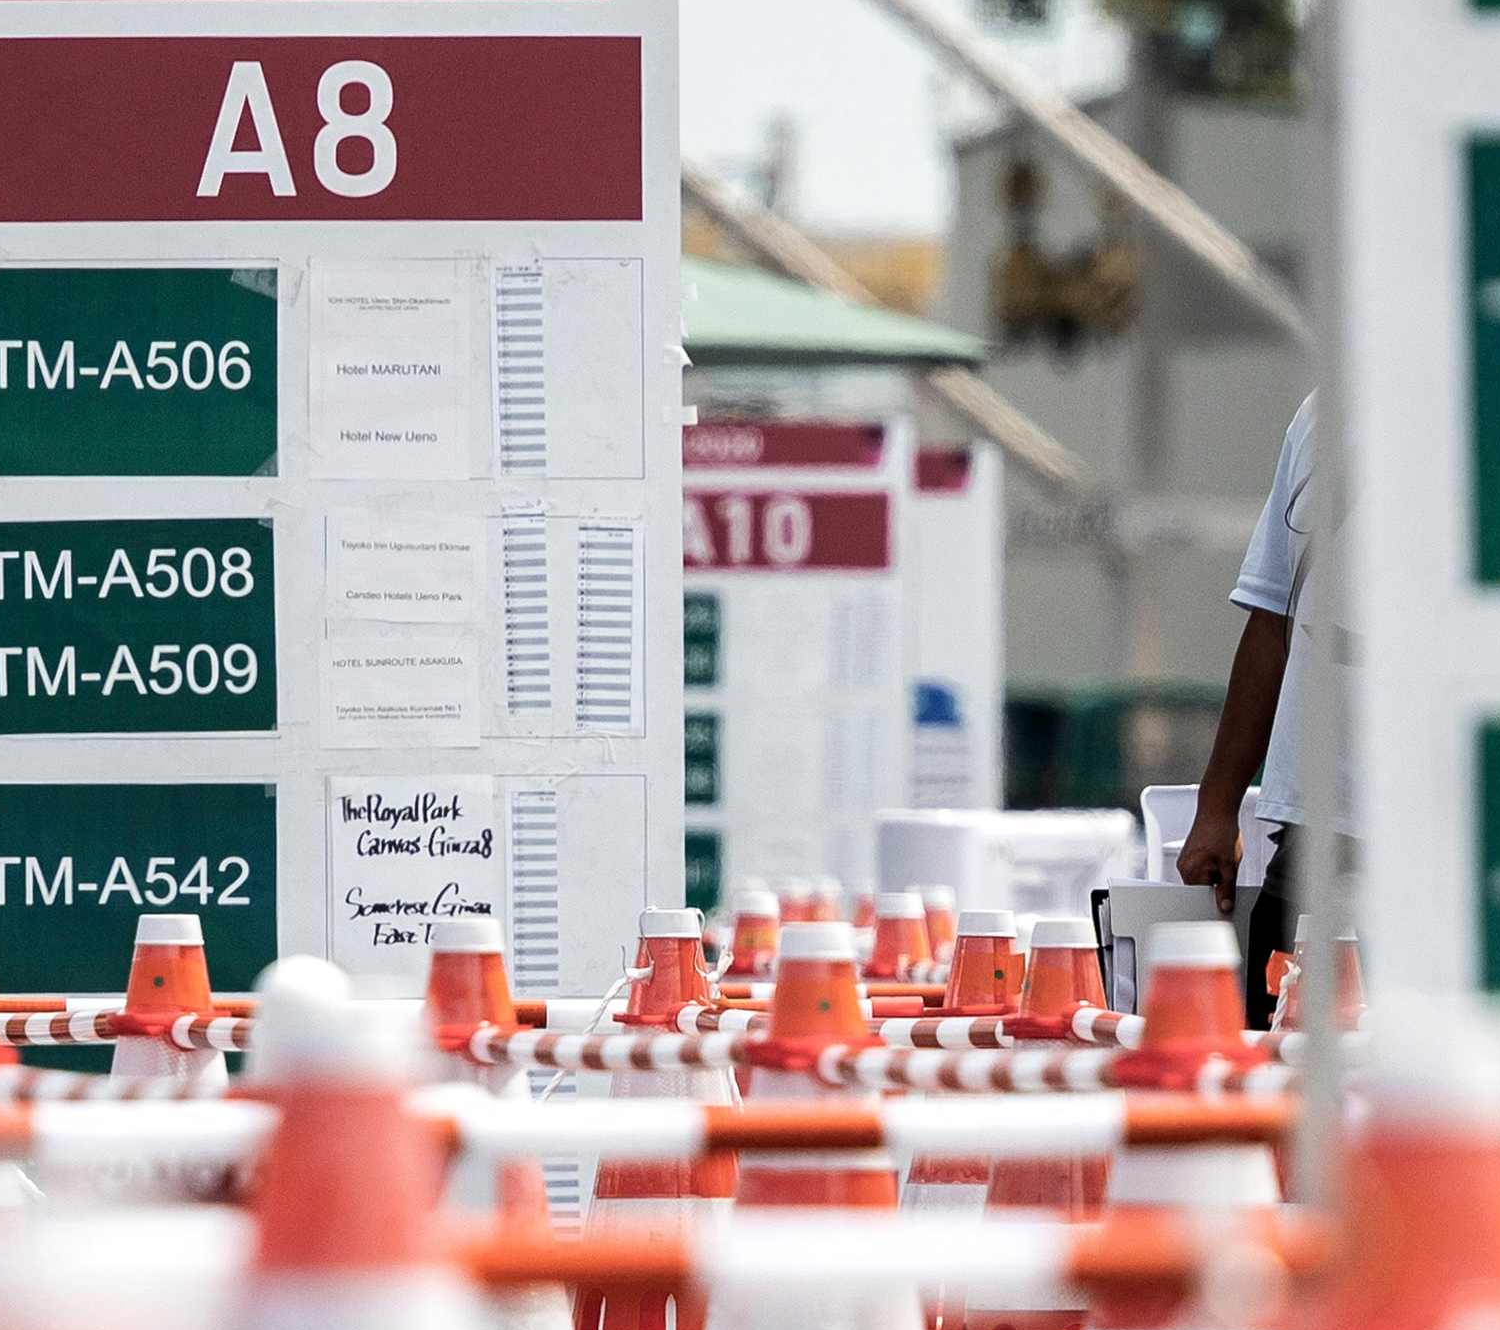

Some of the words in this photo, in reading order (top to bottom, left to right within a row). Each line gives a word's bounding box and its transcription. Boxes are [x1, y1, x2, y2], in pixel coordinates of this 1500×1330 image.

[195, 59, 398, 199] A8
[336, 364, 369, 375] Hotel
[371, 364, 441, 376] MARUTANI
[340, 430, 371, 442] Hotel
[375, 430, 402, 442] New
[404, 431, 438, 443] Ueno
[441, 592, 463, 602] Park
[332, 659, 363, 669] HOTEL
